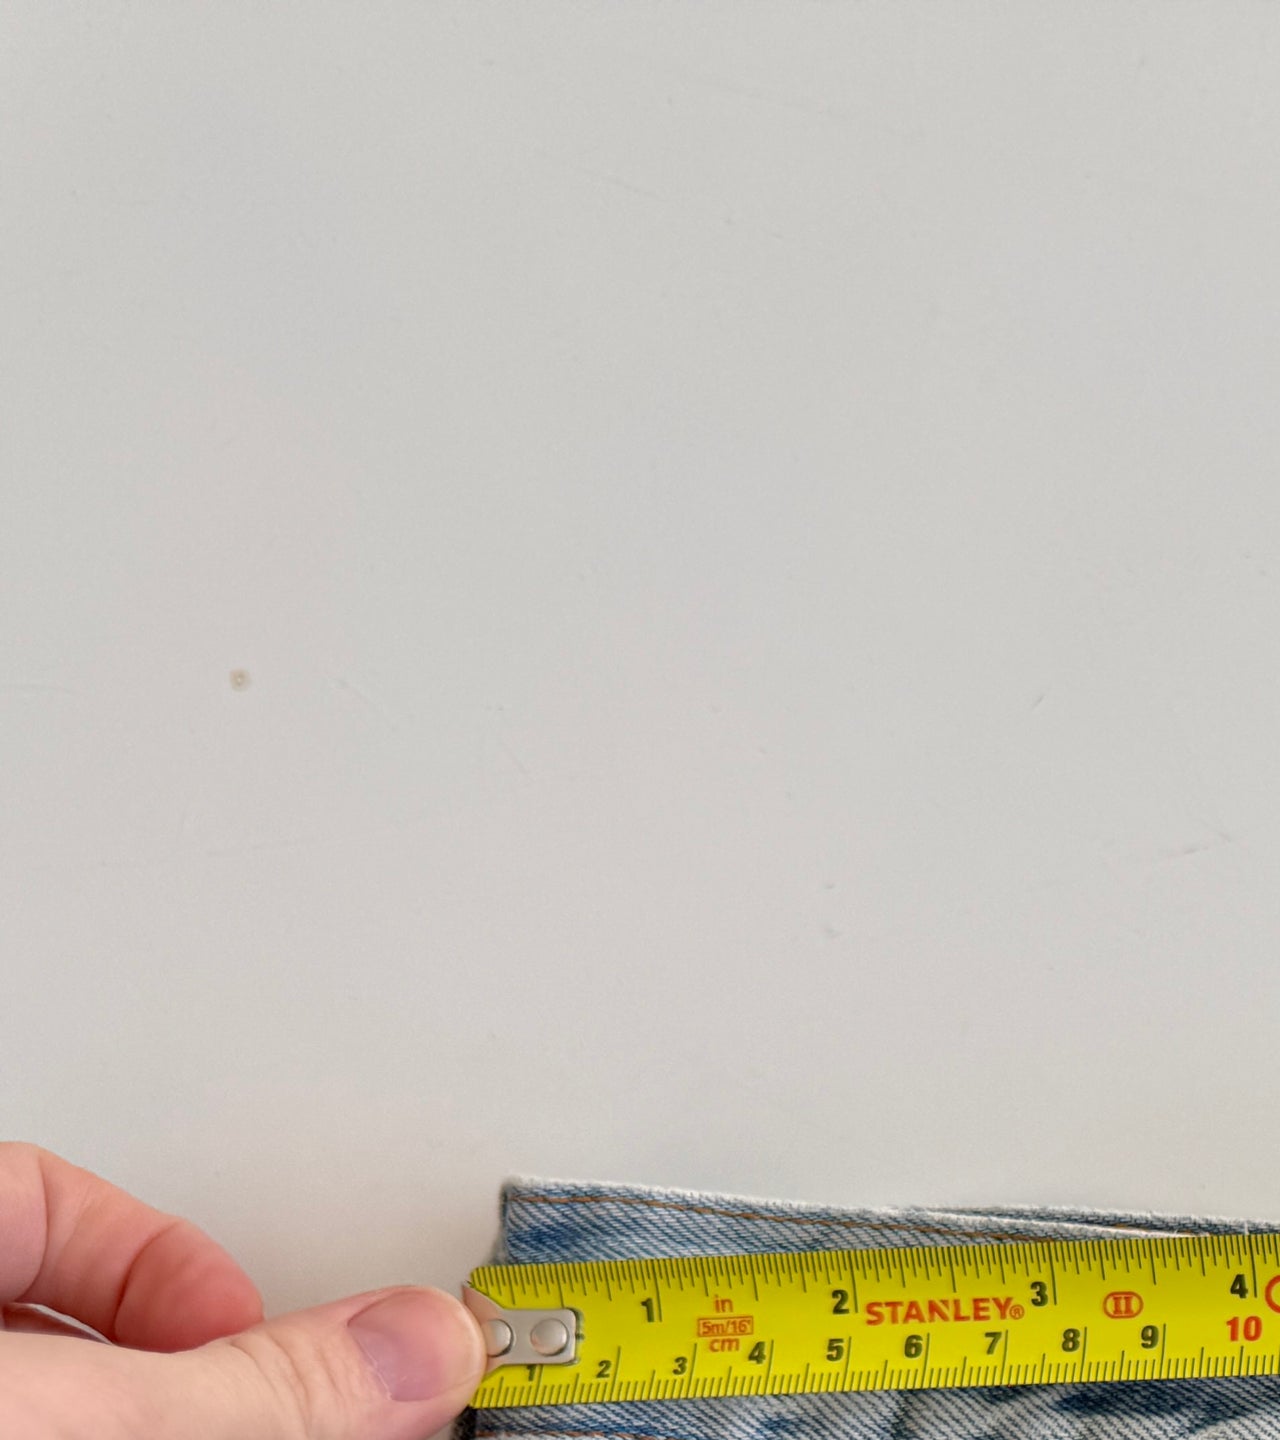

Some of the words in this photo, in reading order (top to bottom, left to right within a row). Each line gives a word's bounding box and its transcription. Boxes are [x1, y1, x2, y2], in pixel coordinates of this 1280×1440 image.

[641, 1299, 653, 1322] 1
[832, 1290, 849, 1315] 2
[1031, 1281, 1048, 1307] 3
[1230, 1274, 1248, 1298] 4
[715, 1295, 733, 1312] in
[526, 1364, 537, 1382] 1
[597, 1360, 611, 1378] 2
[672, 1356, 687, 1375] 3
[748, 1341, 766, 1364] 4
[826, 1339, 844, 1362] 5
[904, 1335, 923, 1358] 6
[985, 1332, 1001, 1355] 7
[1062, 1328, 1080, 1352] 8
[1141, 1325, 1159, 1349] 9
[1226, 1316, 1262, 1341] 10
[709, 1337, 740, 1353] cm
